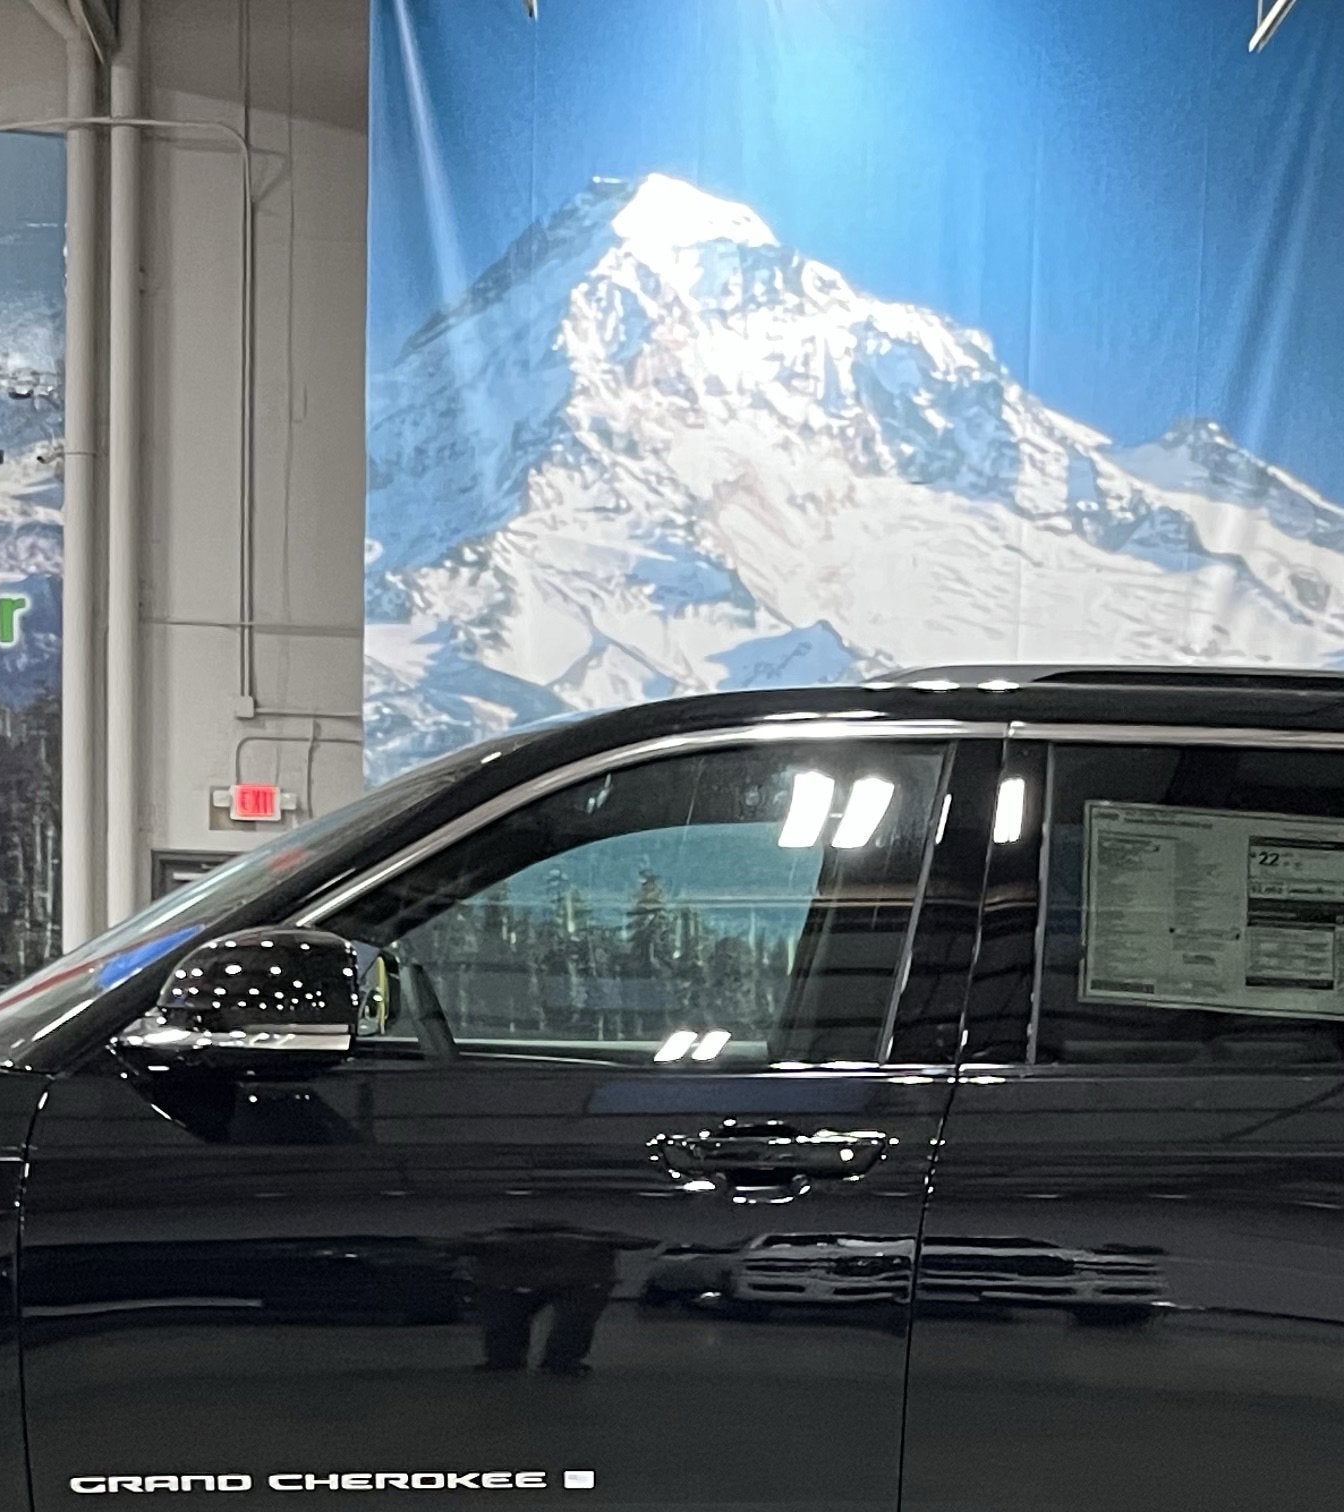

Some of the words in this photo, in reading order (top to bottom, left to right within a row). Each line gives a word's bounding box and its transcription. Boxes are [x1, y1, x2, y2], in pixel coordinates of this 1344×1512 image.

[239, 789, 275, 814] EXIT
[1258, 851, 1281, 867] 22
[69, 1474, 254, 1494] GRAND
[267, 1470, 548, 1492] CHEROKEE
